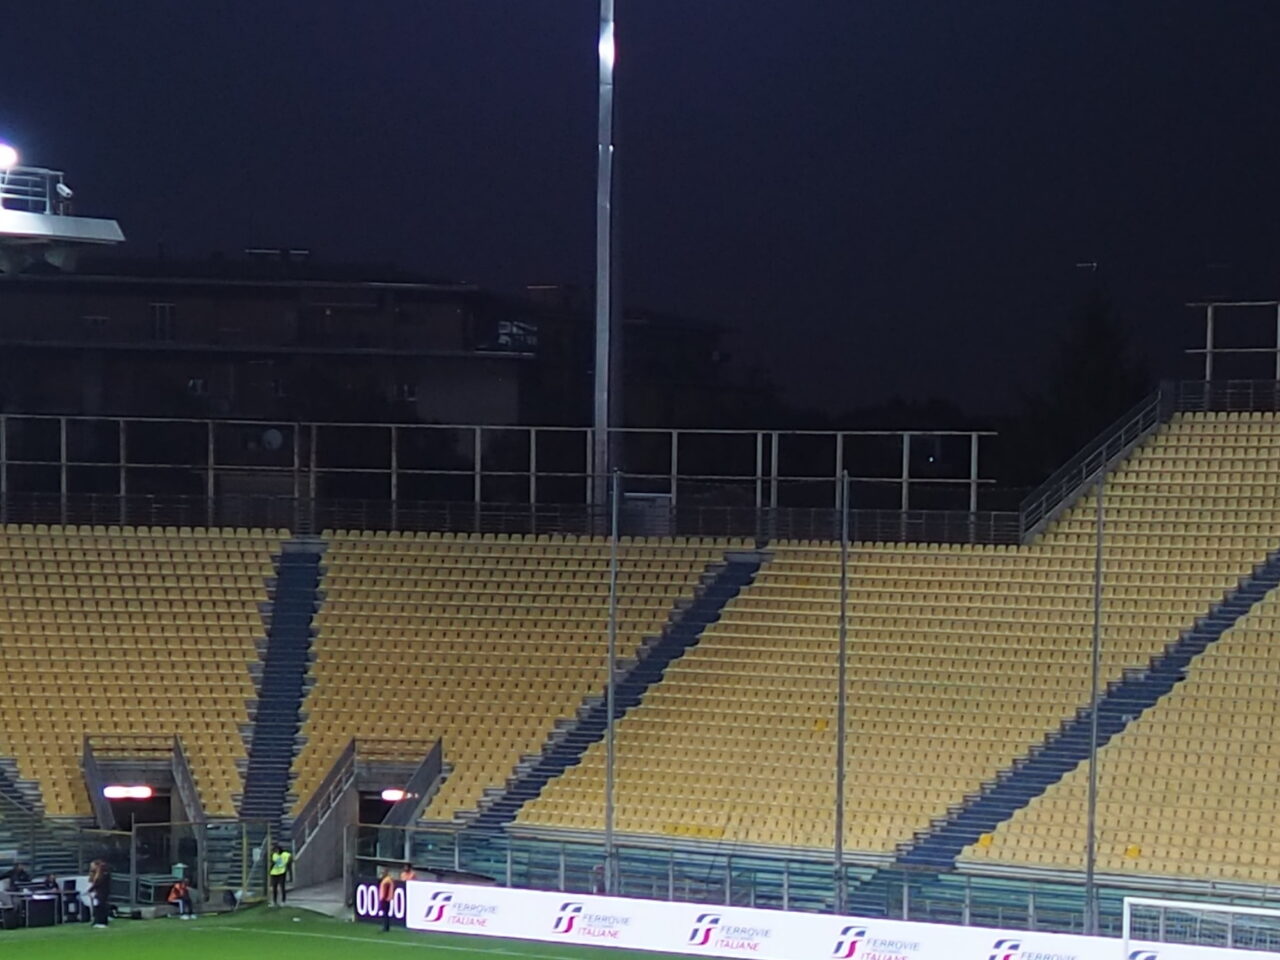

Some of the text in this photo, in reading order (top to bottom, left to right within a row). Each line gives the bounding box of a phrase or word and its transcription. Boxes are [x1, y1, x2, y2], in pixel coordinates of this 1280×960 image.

[453, 903, 496, 916] FERROVIE
[448, 916, 488, 928] ITALIANE
[583, 915, 629, 927] FERROVIE
[578, 926, 620, 939] ITALIANE
[721, 926, 769, 940] FERROVIE
[718, 938, 760, 952] ITALIANE
[867, 939, 918, 953] FERROVIE
